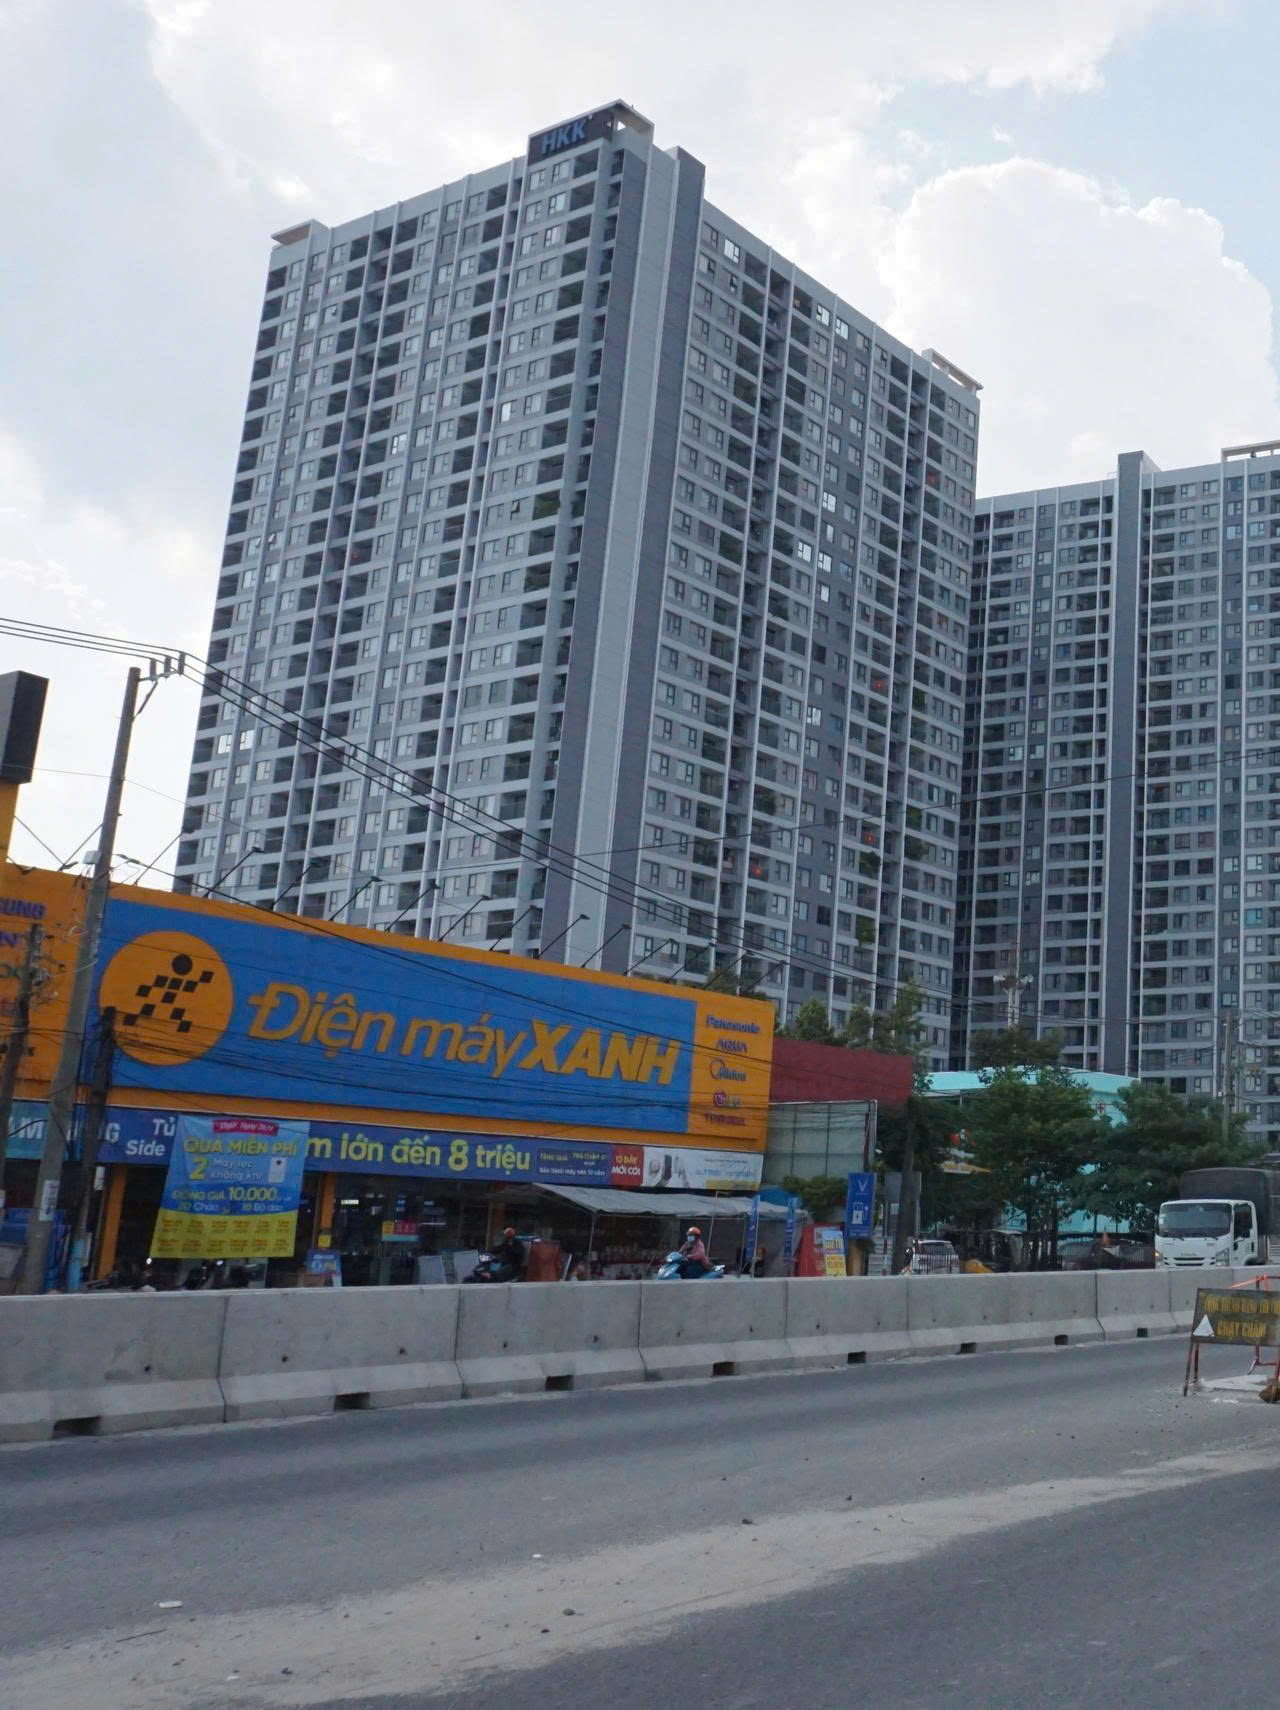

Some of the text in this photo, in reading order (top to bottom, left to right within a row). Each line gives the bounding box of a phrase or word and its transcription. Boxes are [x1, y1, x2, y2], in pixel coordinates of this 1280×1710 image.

[541, 119, 587, 154] HKK
[248, 979, 681, 1085] Điện máy XANH
[153, 1116, 175, 1137] Tủ
[126, 1140, 166, 1156] Side
[340, 1133, 384, 1162] lớn
[391, 1134, 441, 1166] đến
[448, 1139, 469, 1171] 8
[475, 1143, 531, 1175] triệu
[188, 1155, 209, 1180] 2
